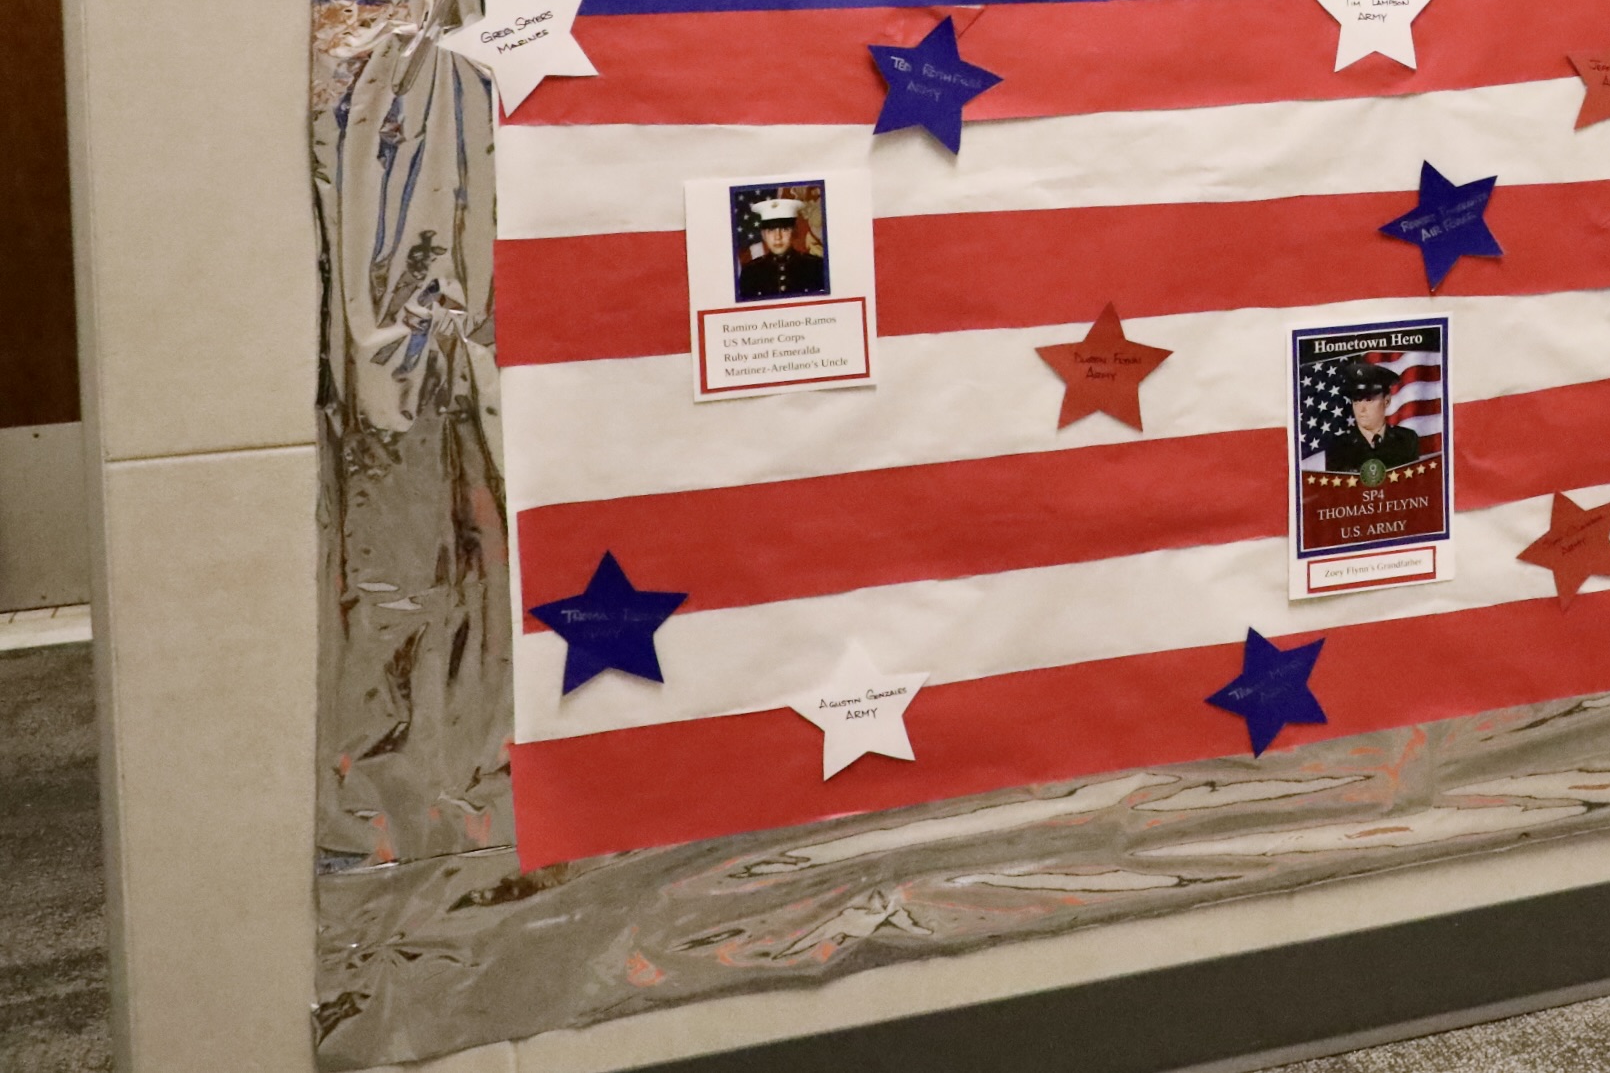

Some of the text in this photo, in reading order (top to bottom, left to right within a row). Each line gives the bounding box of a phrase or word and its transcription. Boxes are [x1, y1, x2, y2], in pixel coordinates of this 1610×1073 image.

[1357, 12, 1387, 23] ARMY
[480, 28, 515, 44] GREG
[497, 29, 549, 55] MARINES
[723, 316, 837, 333] Ramiro Arellano-Ramos
[723, 334, 805, 348] US Marine Corps
[1314, 332, 1423, 354] Hometown Hero
[724, 345, 820, 363] Ruby and Esmeralda
[725, 357, 848, 377] Martinez-Arellano's Uncle
[1362, 489, 1385, 502] SP4
[1317, 496, 1429, 521] THOMAS J FLYNN
[1340, 519, 1407, 539] U.S. ARMY
[1325, 569, 1344, 579] Zoey
[1376, 559, 1422, 571] Grandfather
[819, 698, 861, 709] AGUSTIN
[845, 707, 878, 721] ARMY
